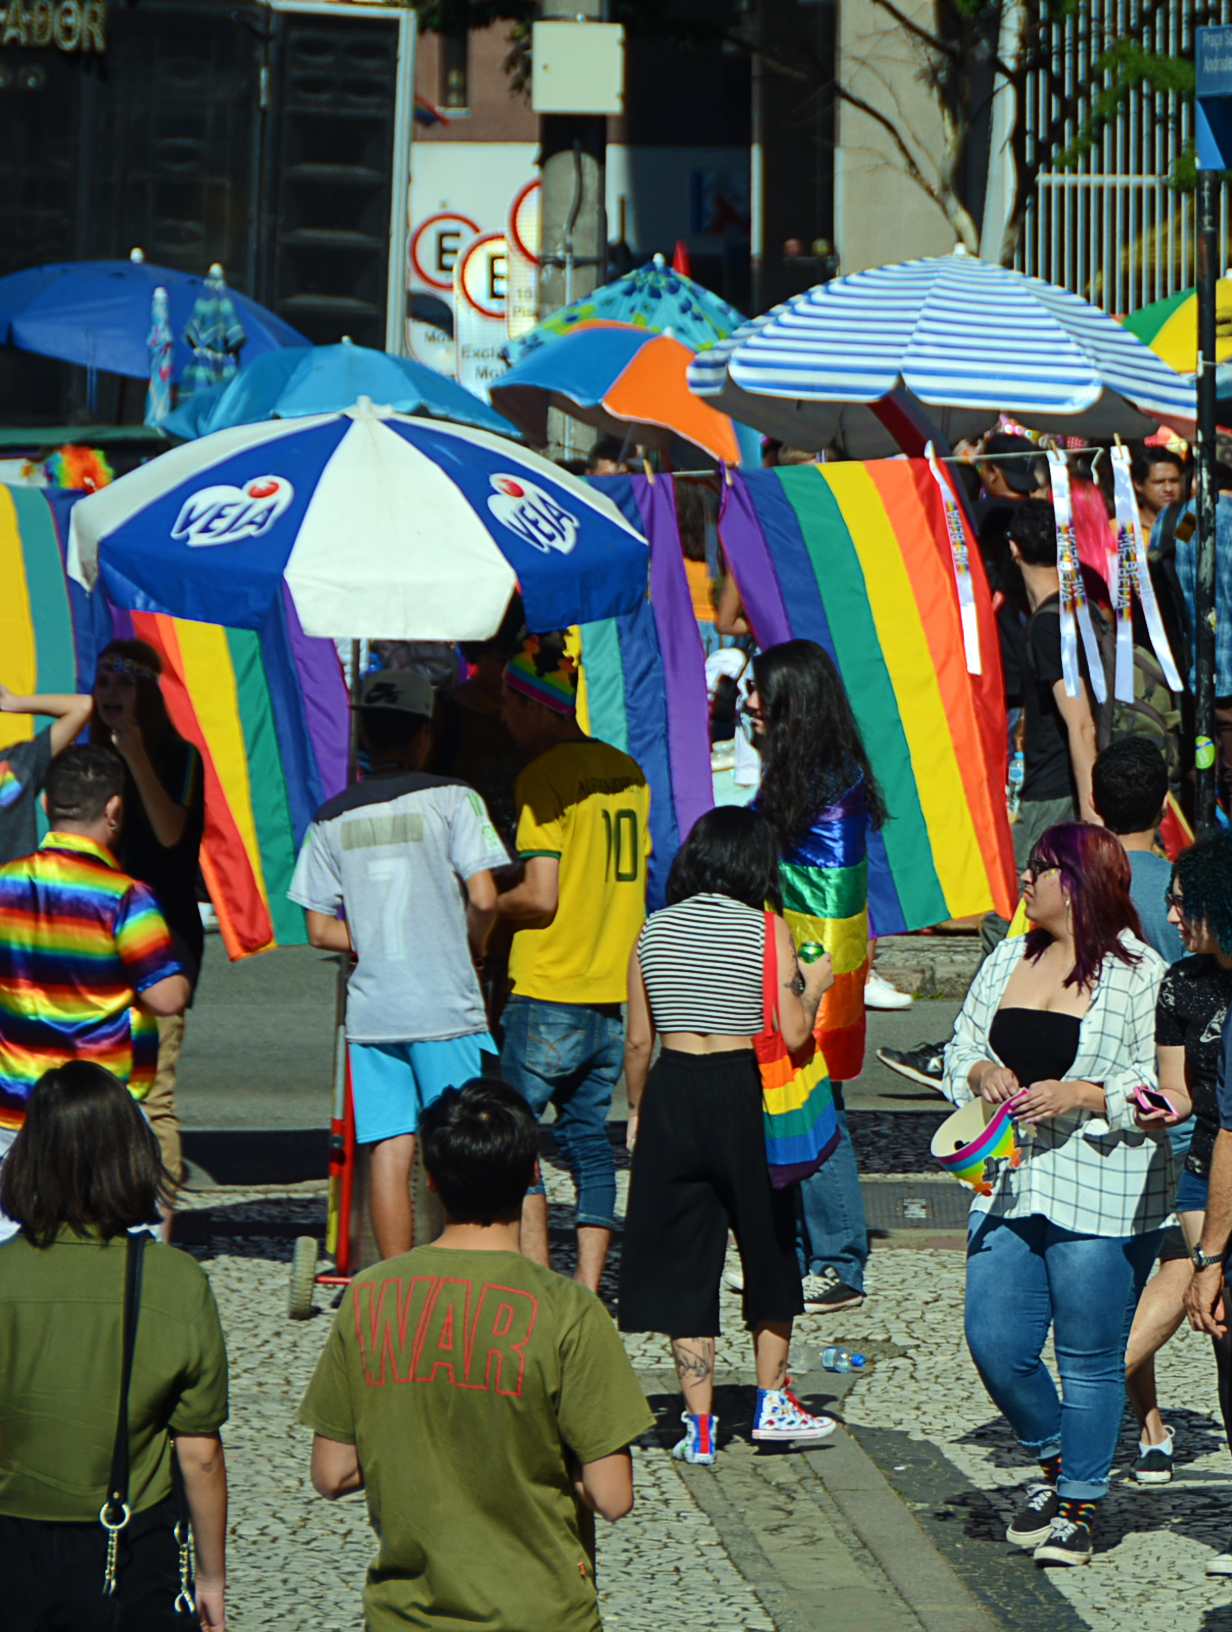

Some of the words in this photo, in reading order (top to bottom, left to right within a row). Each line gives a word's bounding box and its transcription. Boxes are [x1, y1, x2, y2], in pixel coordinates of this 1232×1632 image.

[0, 0, 105, 51] ADOR
[437, 232, 461, 272] E
[488, 255, 507, 299] E
[178, 501, 278, 539] VEJA
[505, 492, 575, 549] VEJA
[601, 809, 638, 882] 10
[366, 857, 408, 961] 7
[353, 1276, 538, 1396] WAR
